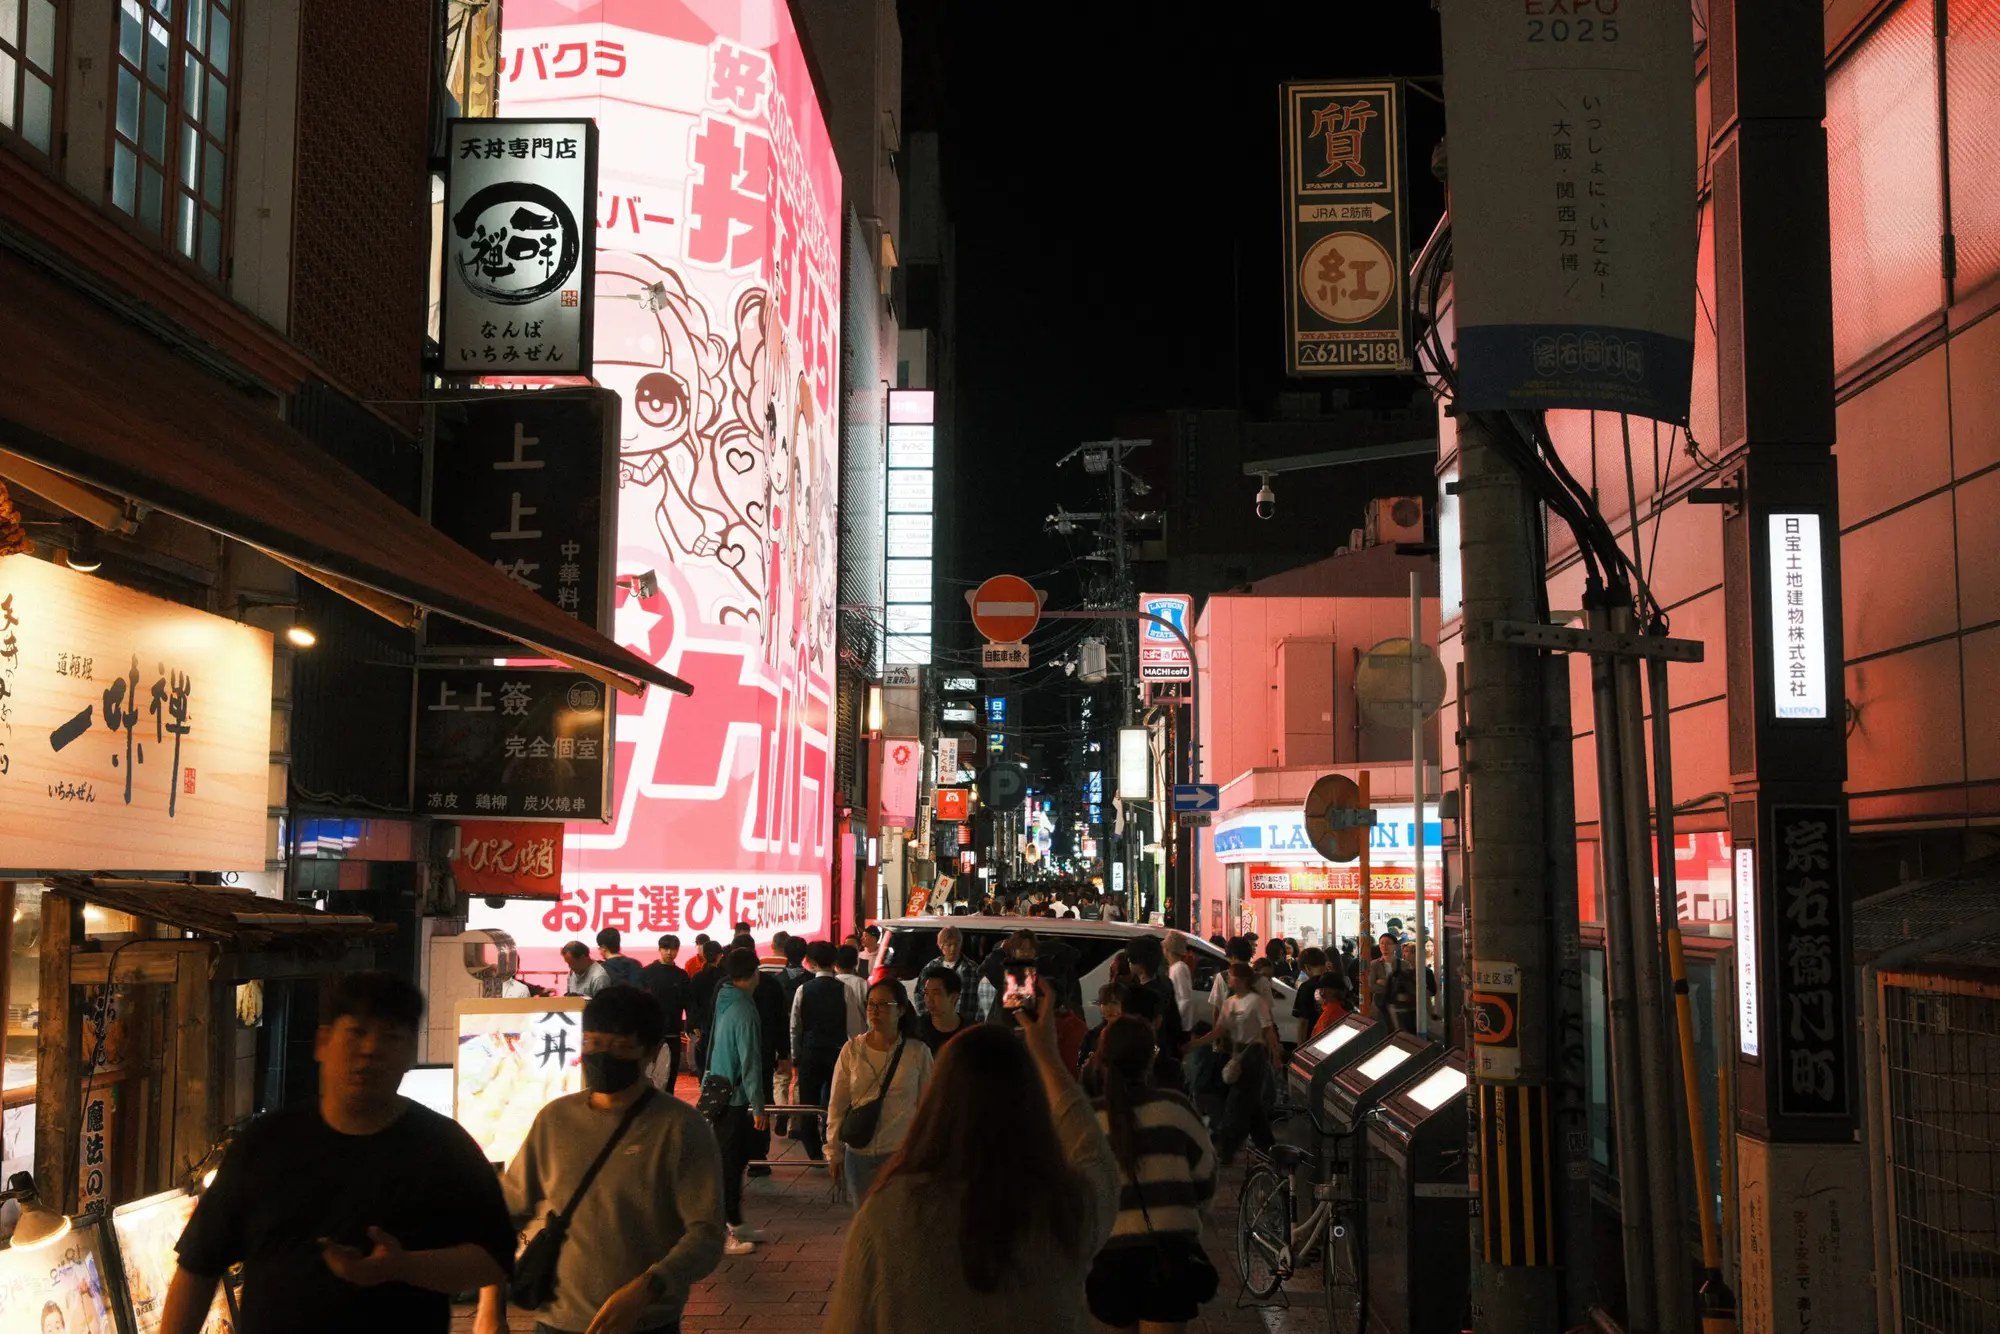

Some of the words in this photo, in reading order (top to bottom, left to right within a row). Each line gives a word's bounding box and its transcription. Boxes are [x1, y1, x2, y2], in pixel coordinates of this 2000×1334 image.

[1527, 19, 1619, 41] 2025
[499, 40, 627, 82] バクラ
[459, 137, 578, 160] 天丼専門店
[1309, 100, 1378, 177] 質
[1552, 119, 1580, 272] 大阪・関西万博
[1312, 208, 1338, 219] JRA
[480, 320, 545, 339] なんば
[460, 342, 564, 362] いちみぜん
[557, 540, 581, 620] 中華料
[1150, 602, 1184, 610] LAWSON
[1785, 518, 1807, 697] 日宝土地建物株式会社
[985, 650, 1027, 662] 自転車を除く
[1172, 650, 1189, 659] ATM
[56, 652, 93, 681] 道頓堀
[1144, 668, 1170, 676] MACHI
[1171, 667, 1188, 675] café
[504, 735, 599, 760] 完全個室
[48, 781, 96, 803] いちみぜん
[1269, 821, 1399, 850] LAN
